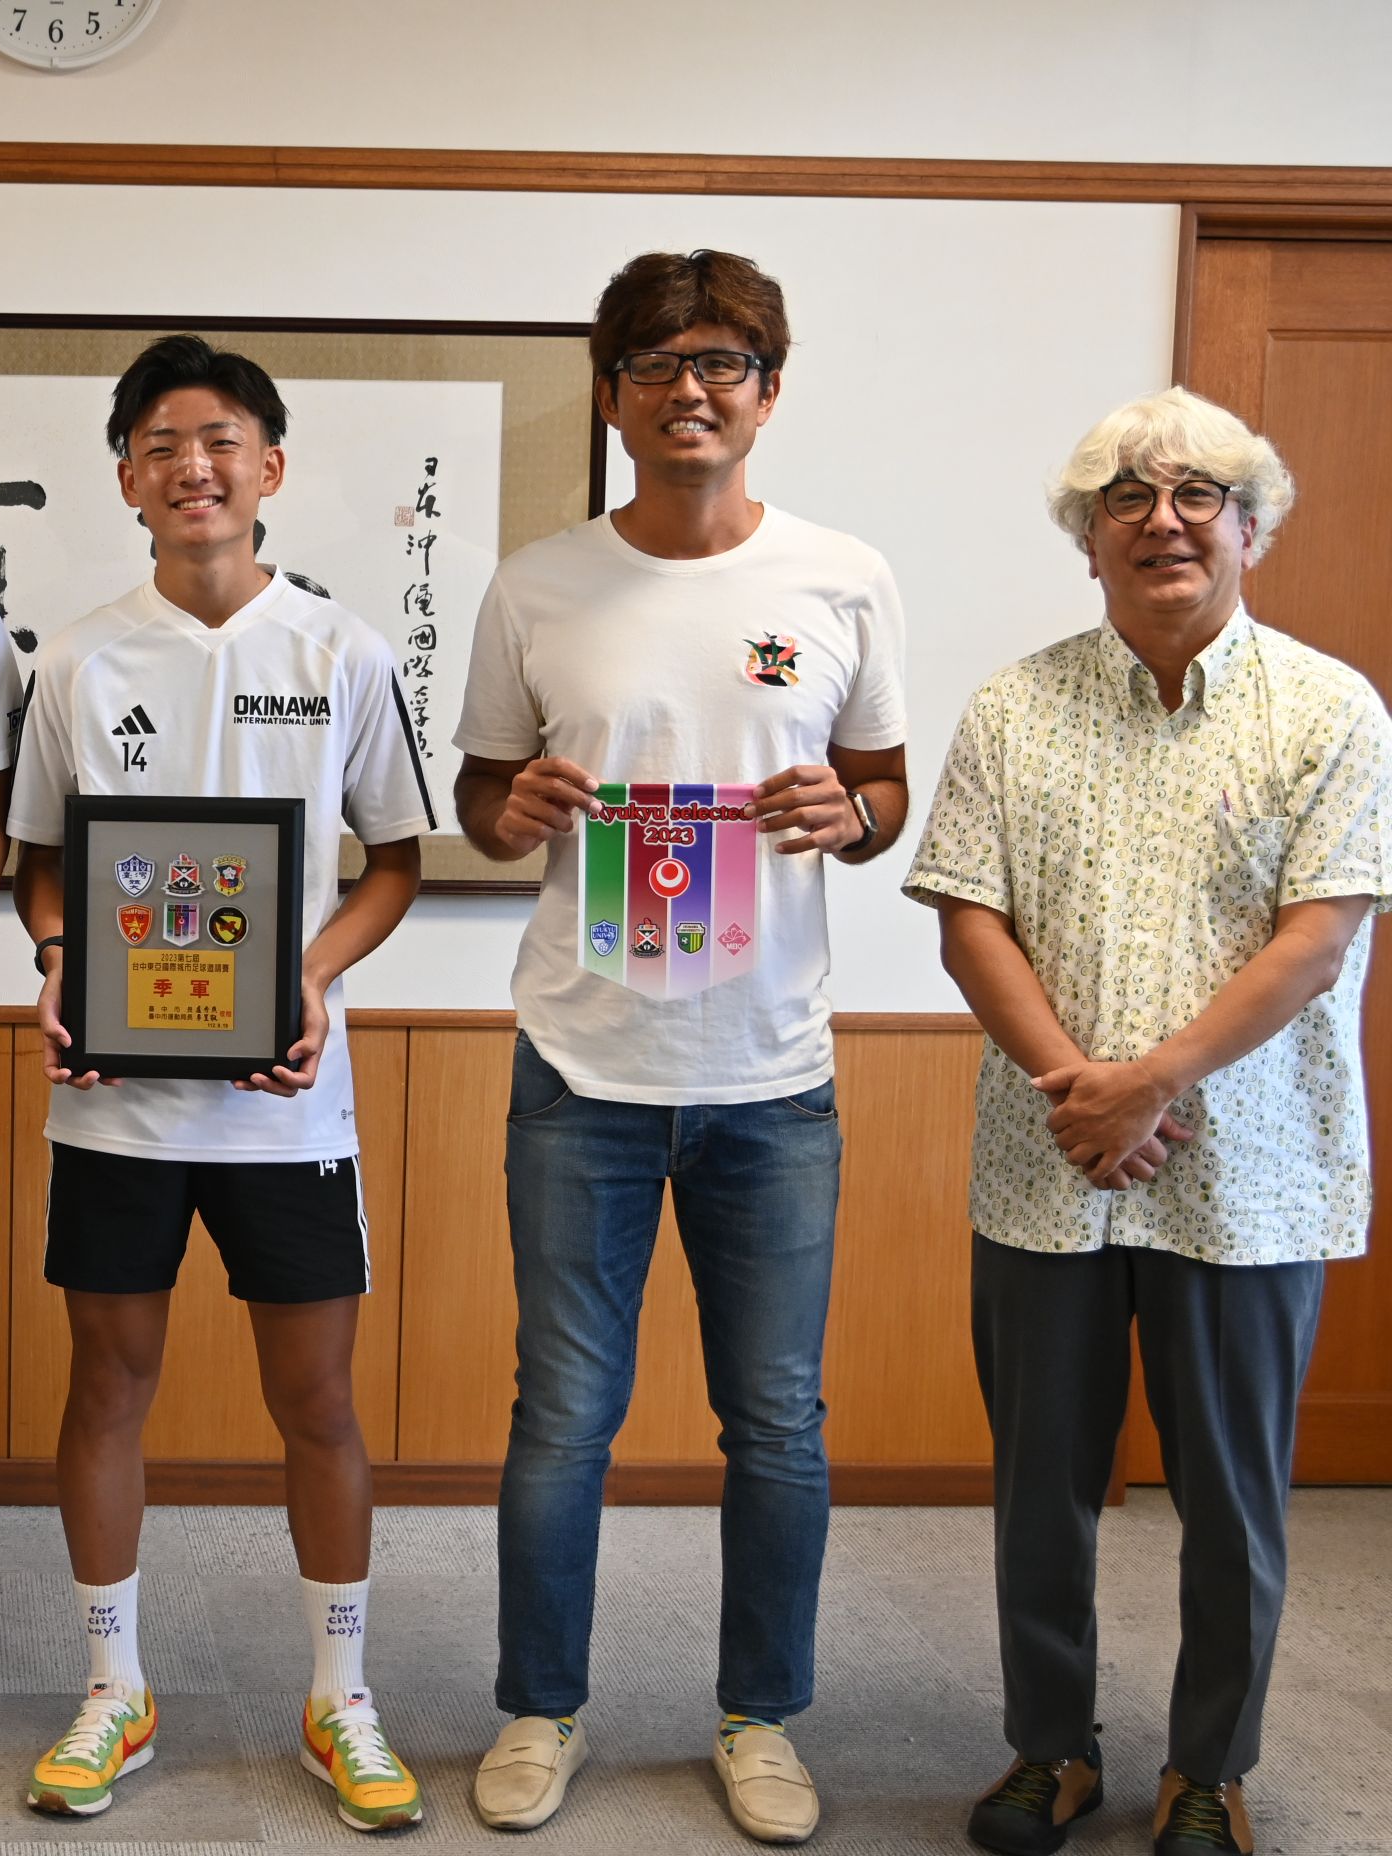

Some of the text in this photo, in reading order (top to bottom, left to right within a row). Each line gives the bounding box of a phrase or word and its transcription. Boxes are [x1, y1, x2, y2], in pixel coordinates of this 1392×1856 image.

[13, 8, 27, 32] 7
[85, 11, 101, 36] 5
[48, 19, 64, 43] 6
[234, 694, 331, 717] OKINAWA
[233, 716, 332, 726] INTERNATIONAL UNIV.
[122, 742, 147, 772] 14
[644, 826, 695, 845] 2023
[318, 1160, 338, 1177] 14
[89, 1605, 116, 1615] for
[328, 1604, 358, 1613] for
[88, 1615, 118, 1627] city
[327, 1614, 359, 1626] city
[87, 1625, 121, 1638] boys
[326, 1625, 362, 1638] boys
[351, 1692, 364, 1700] NIKE
